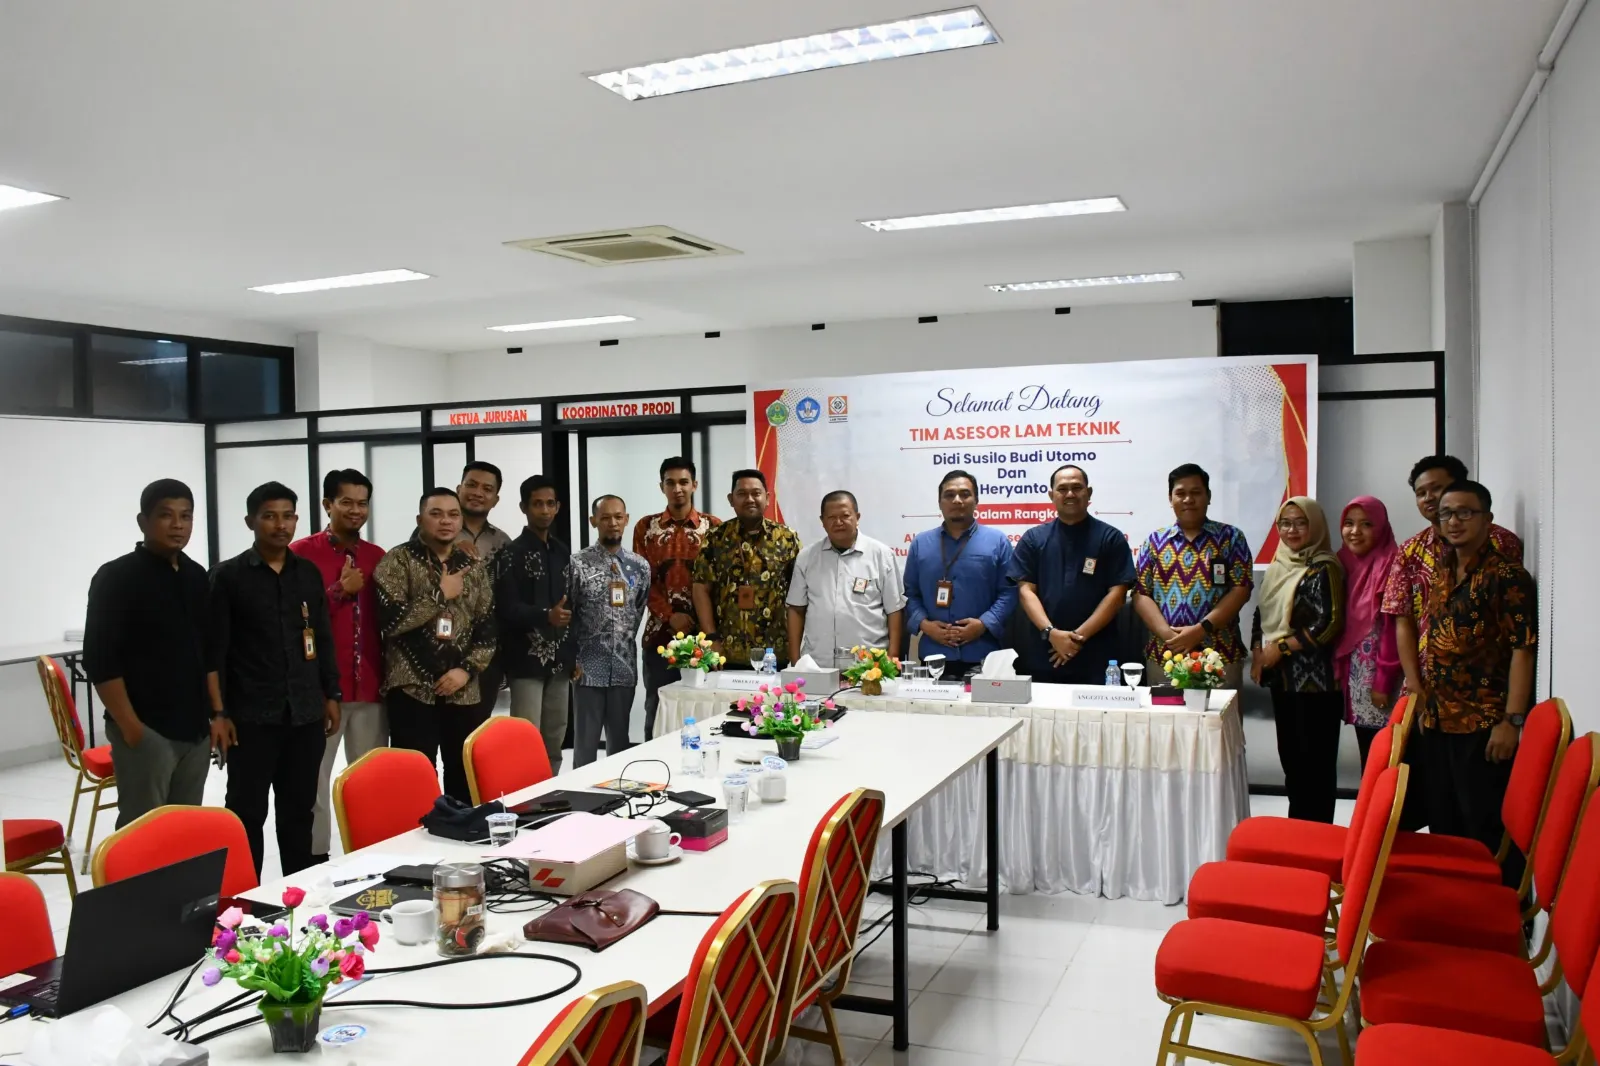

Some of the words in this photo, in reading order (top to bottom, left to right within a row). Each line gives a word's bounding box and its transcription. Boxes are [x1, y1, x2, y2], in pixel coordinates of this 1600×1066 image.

[926, 387, 1014, 417] Selamat
[1017, 384, 1103, 418] Datang
[449, 412, 480, 425] KETUA
[483, 409, 528, 423] JURUSAN
[562, 403, 638, 420] KOORDINATOR
[642, 401, 675, 416] PRODI
[909, 427, 939, 442] TIM
[943, 425, 1011, 441] ASESOR
[1015, 423, 1052, 438] LAM
[1056, 420, 1121, 437] TEKNIK
[933, 452, 960, 466] Didi
[963, 451, 1007, 465] Susilo
[1010, 450, 1043, 464] Budi
[1046, 449, 1097, 463] Utomo
[997, 467, 1027, 479] Dan
[980, 482, 1048, 499] Heryanto
